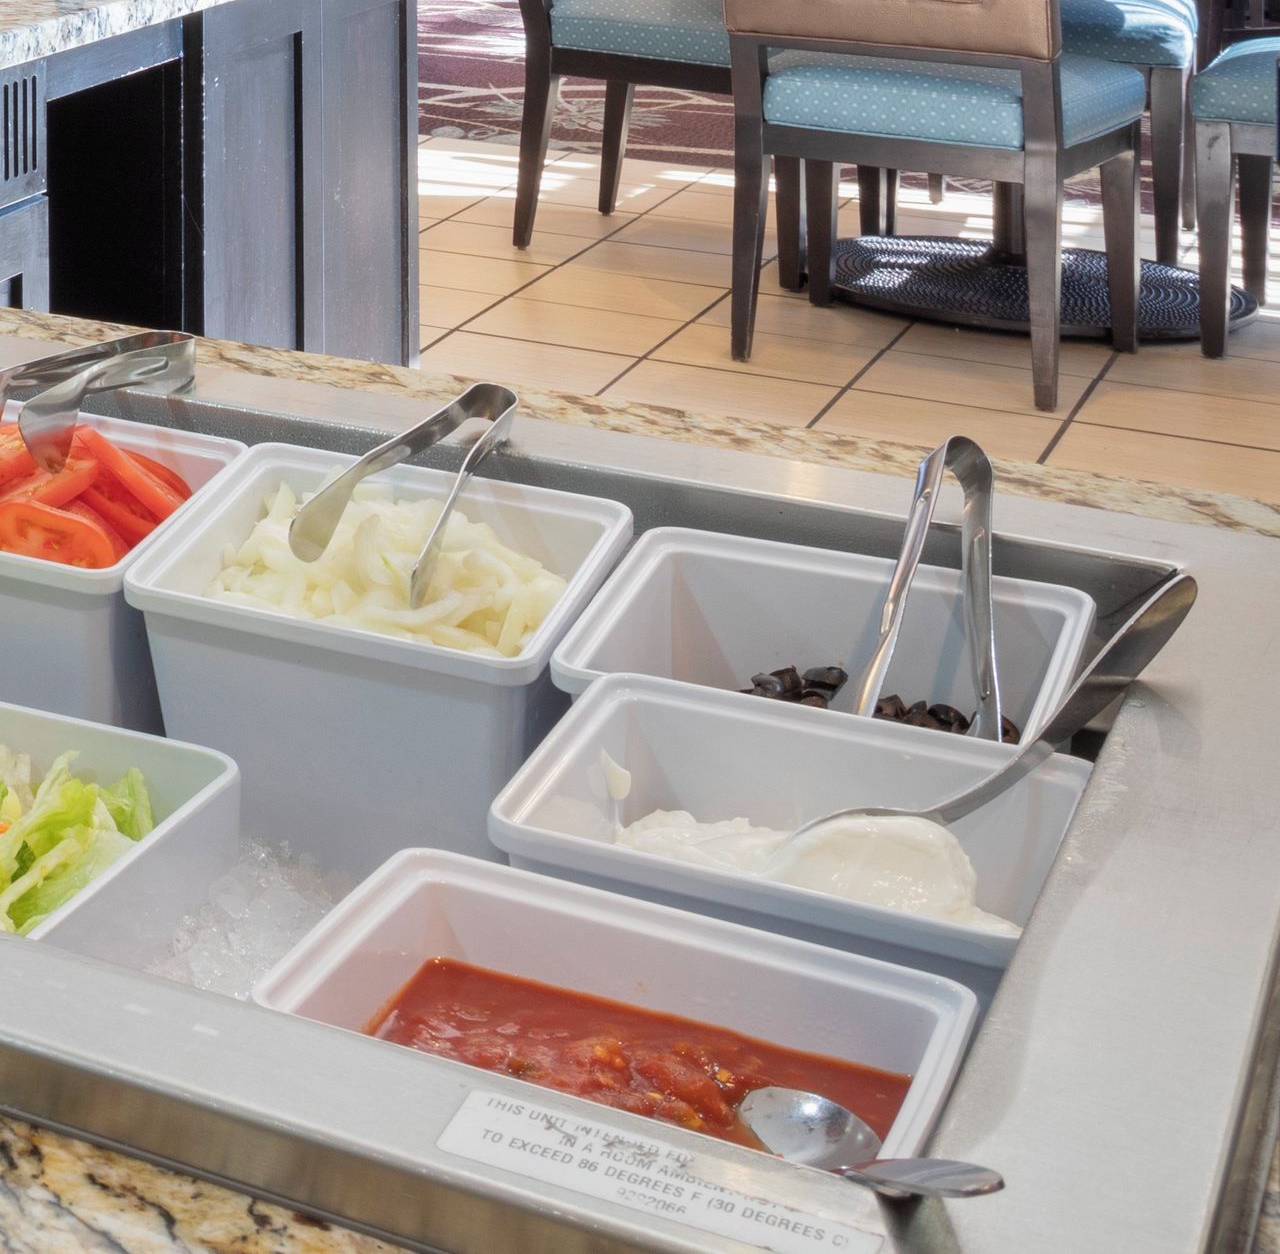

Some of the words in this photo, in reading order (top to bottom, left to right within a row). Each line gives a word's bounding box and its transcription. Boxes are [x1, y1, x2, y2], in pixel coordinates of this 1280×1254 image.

[486, 1098, 525, 1116] THIS
[529, 1110, 568, 1128] UNIT
[558, 1134, 578, 1148] IN
[582, 1143, 593, 1153] A
[600, 1149, 657, 1171] ROOM
[481, 1129, 504, 1144] TO
[508, 1137, 574, 1165] EXCEED
[578, 1159, 599, 1172] 86
[604, 1165, 685, 1197] DEGREES
[690, 1192, 703, 1202] F
[707, 1197, 736, 1214] (30
[741, 1206, 826, 1241] DEGREES
